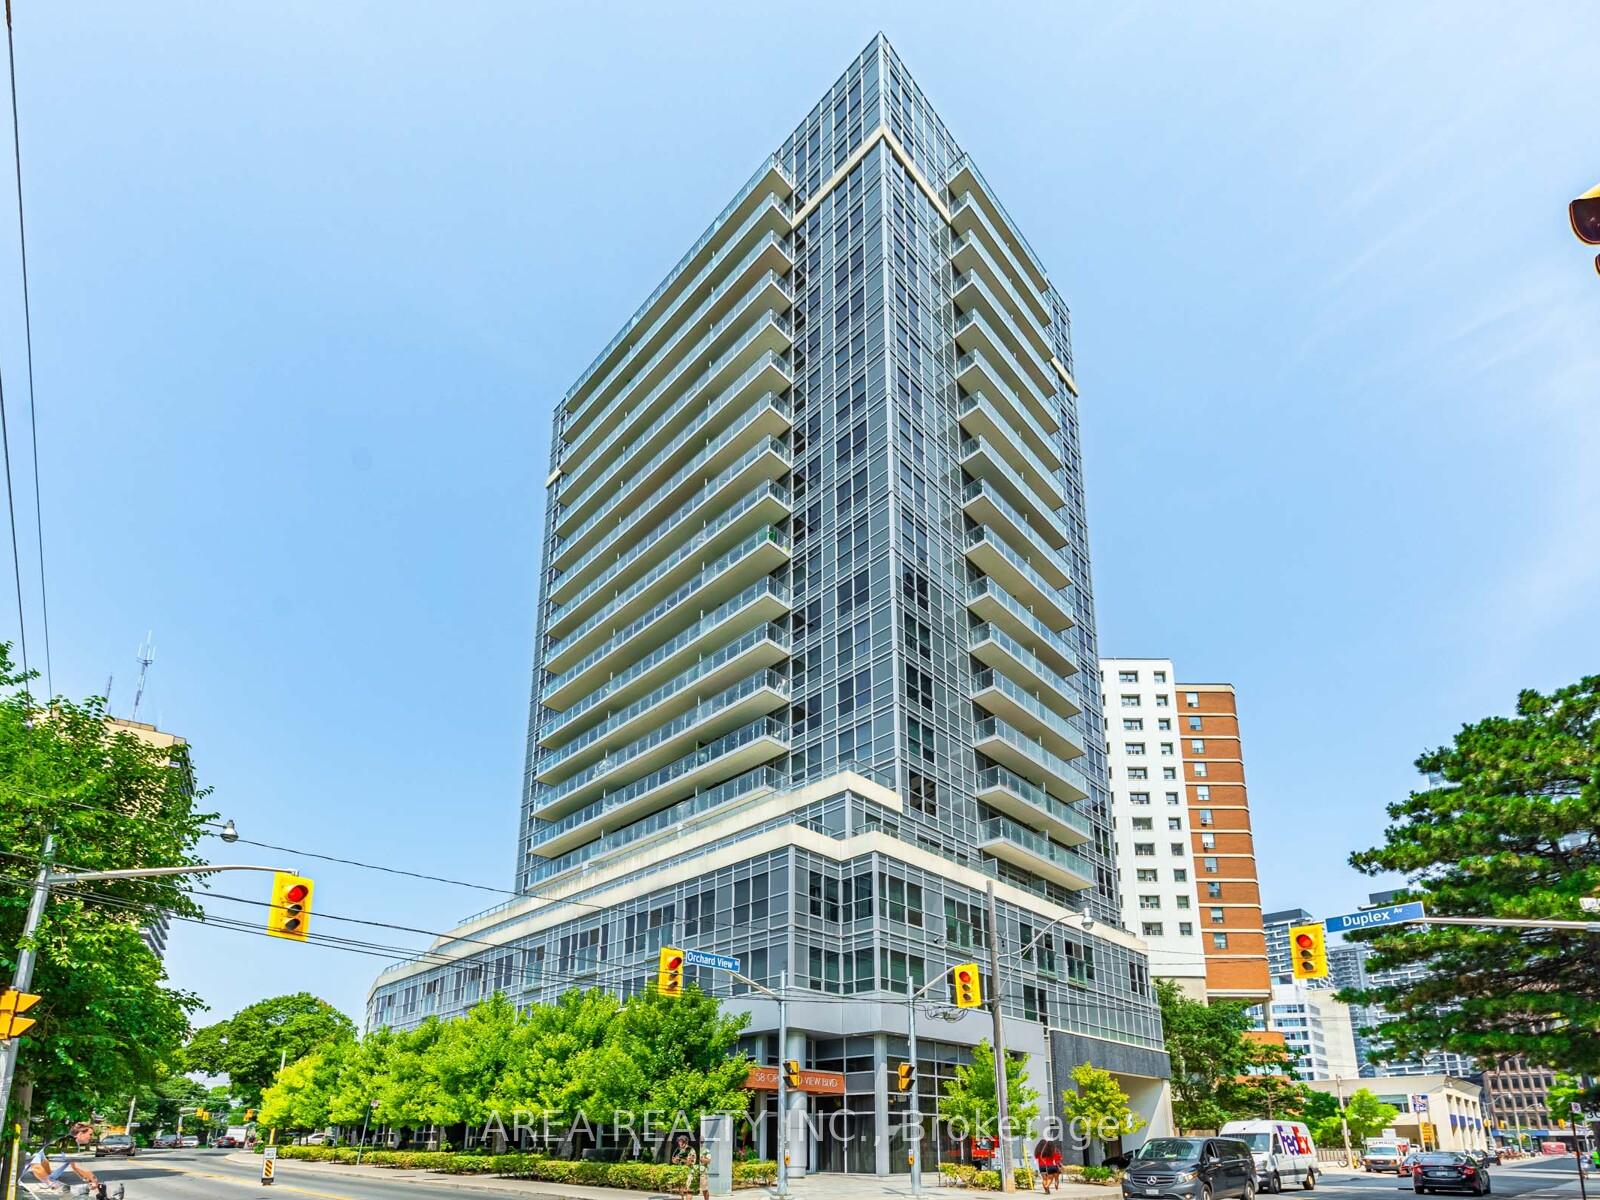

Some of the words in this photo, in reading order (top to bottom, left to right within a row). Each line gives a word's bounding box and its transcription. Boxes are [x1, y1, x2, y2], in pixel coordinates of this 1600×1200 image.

[1342, 911, 1391, 927] Duplex
[687, 952, 716, 966] Orchard
[717, 957, 733, 969] View
[755, 1072, 766, 1082] 58
[805, 1075, 821, 1086] VIEW
[821, 1077, 838, 1088] BLVD
[1276, 1124, 1312, 1155] FedEx
